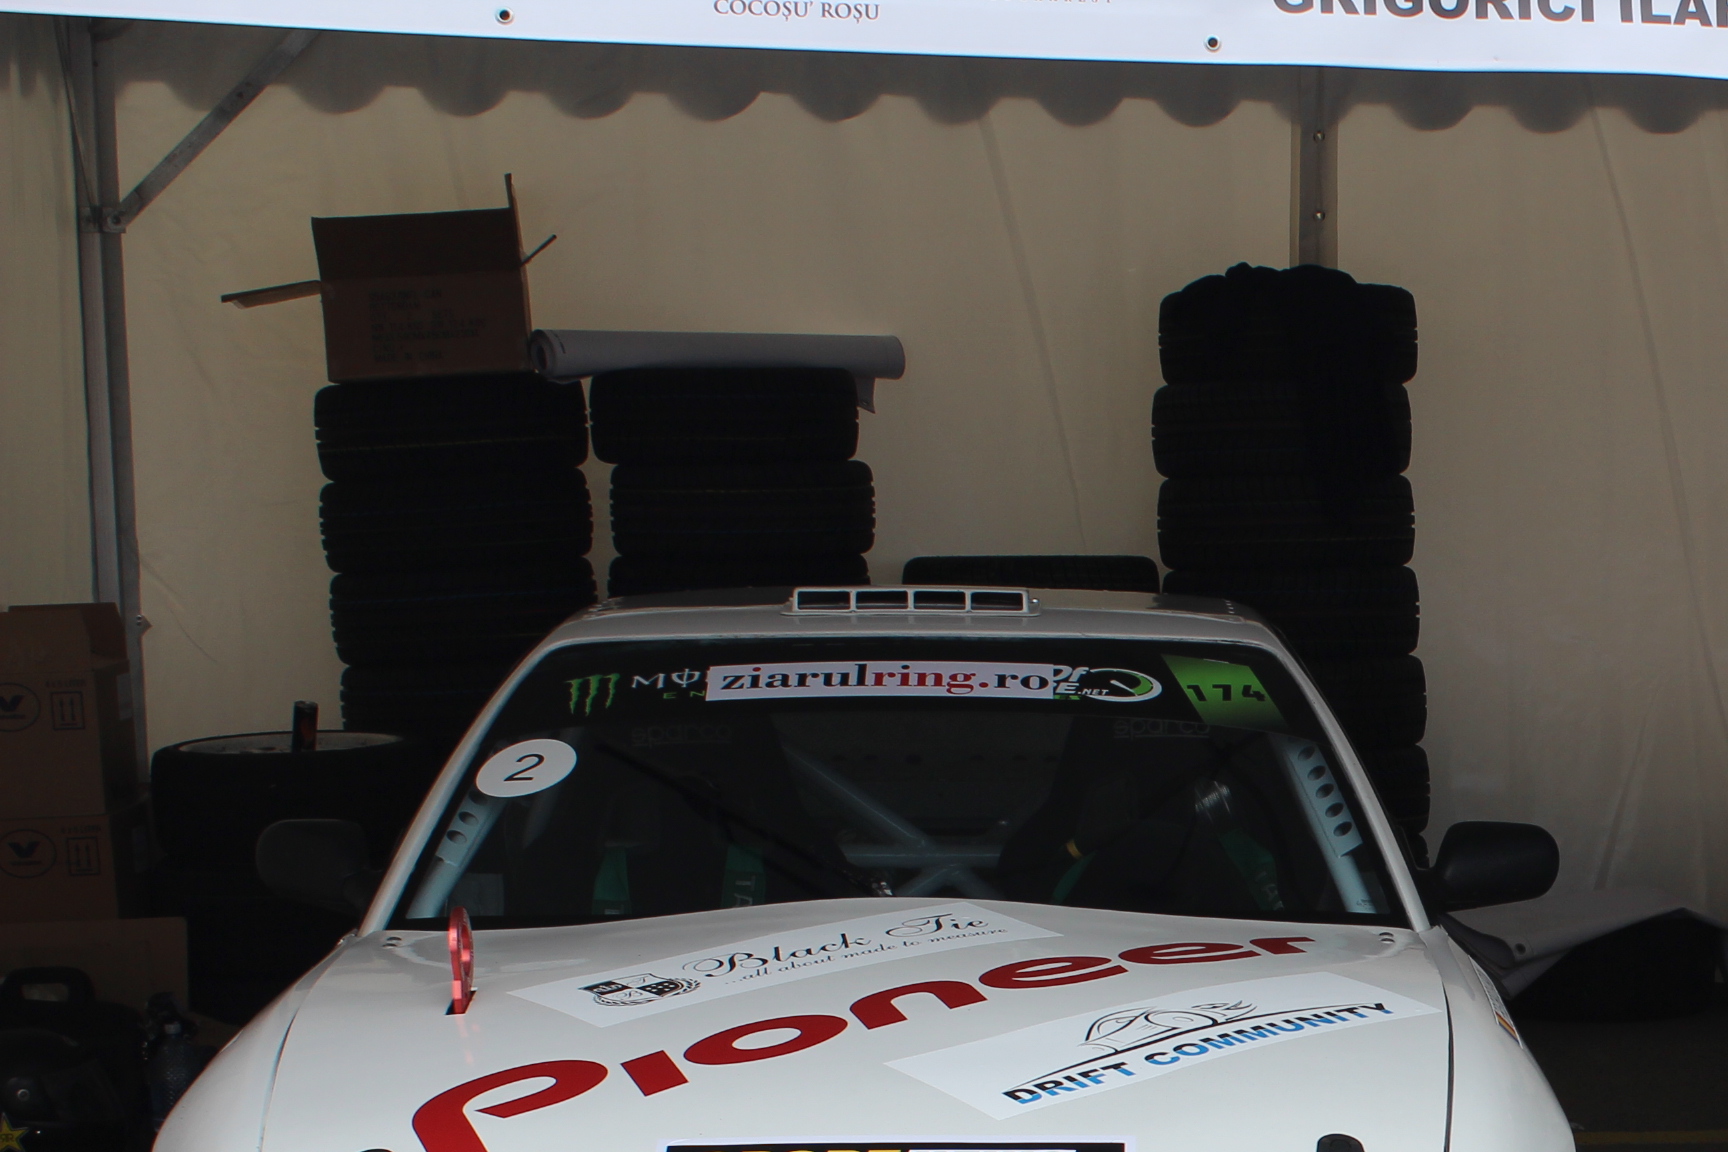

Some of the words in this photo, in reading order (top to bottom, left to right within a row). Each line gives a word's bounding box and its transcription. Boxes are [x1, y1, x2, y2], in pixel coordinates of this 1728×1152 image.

[720, 661, 1049, 696] ziarulring.ro
[1186, 684, 1266, 702] 174
[507, 754, 546, 783] 2
[681, 933, 871, 977] Black
[884, 912, 989, 938] Tie
[841, 943, 897, 960] made
[902, 938, 920, 949] to
[1002, 1061, 1137, 1104] DRIFT
[1143, 1002, 1395, 1066] COMMUNITY
